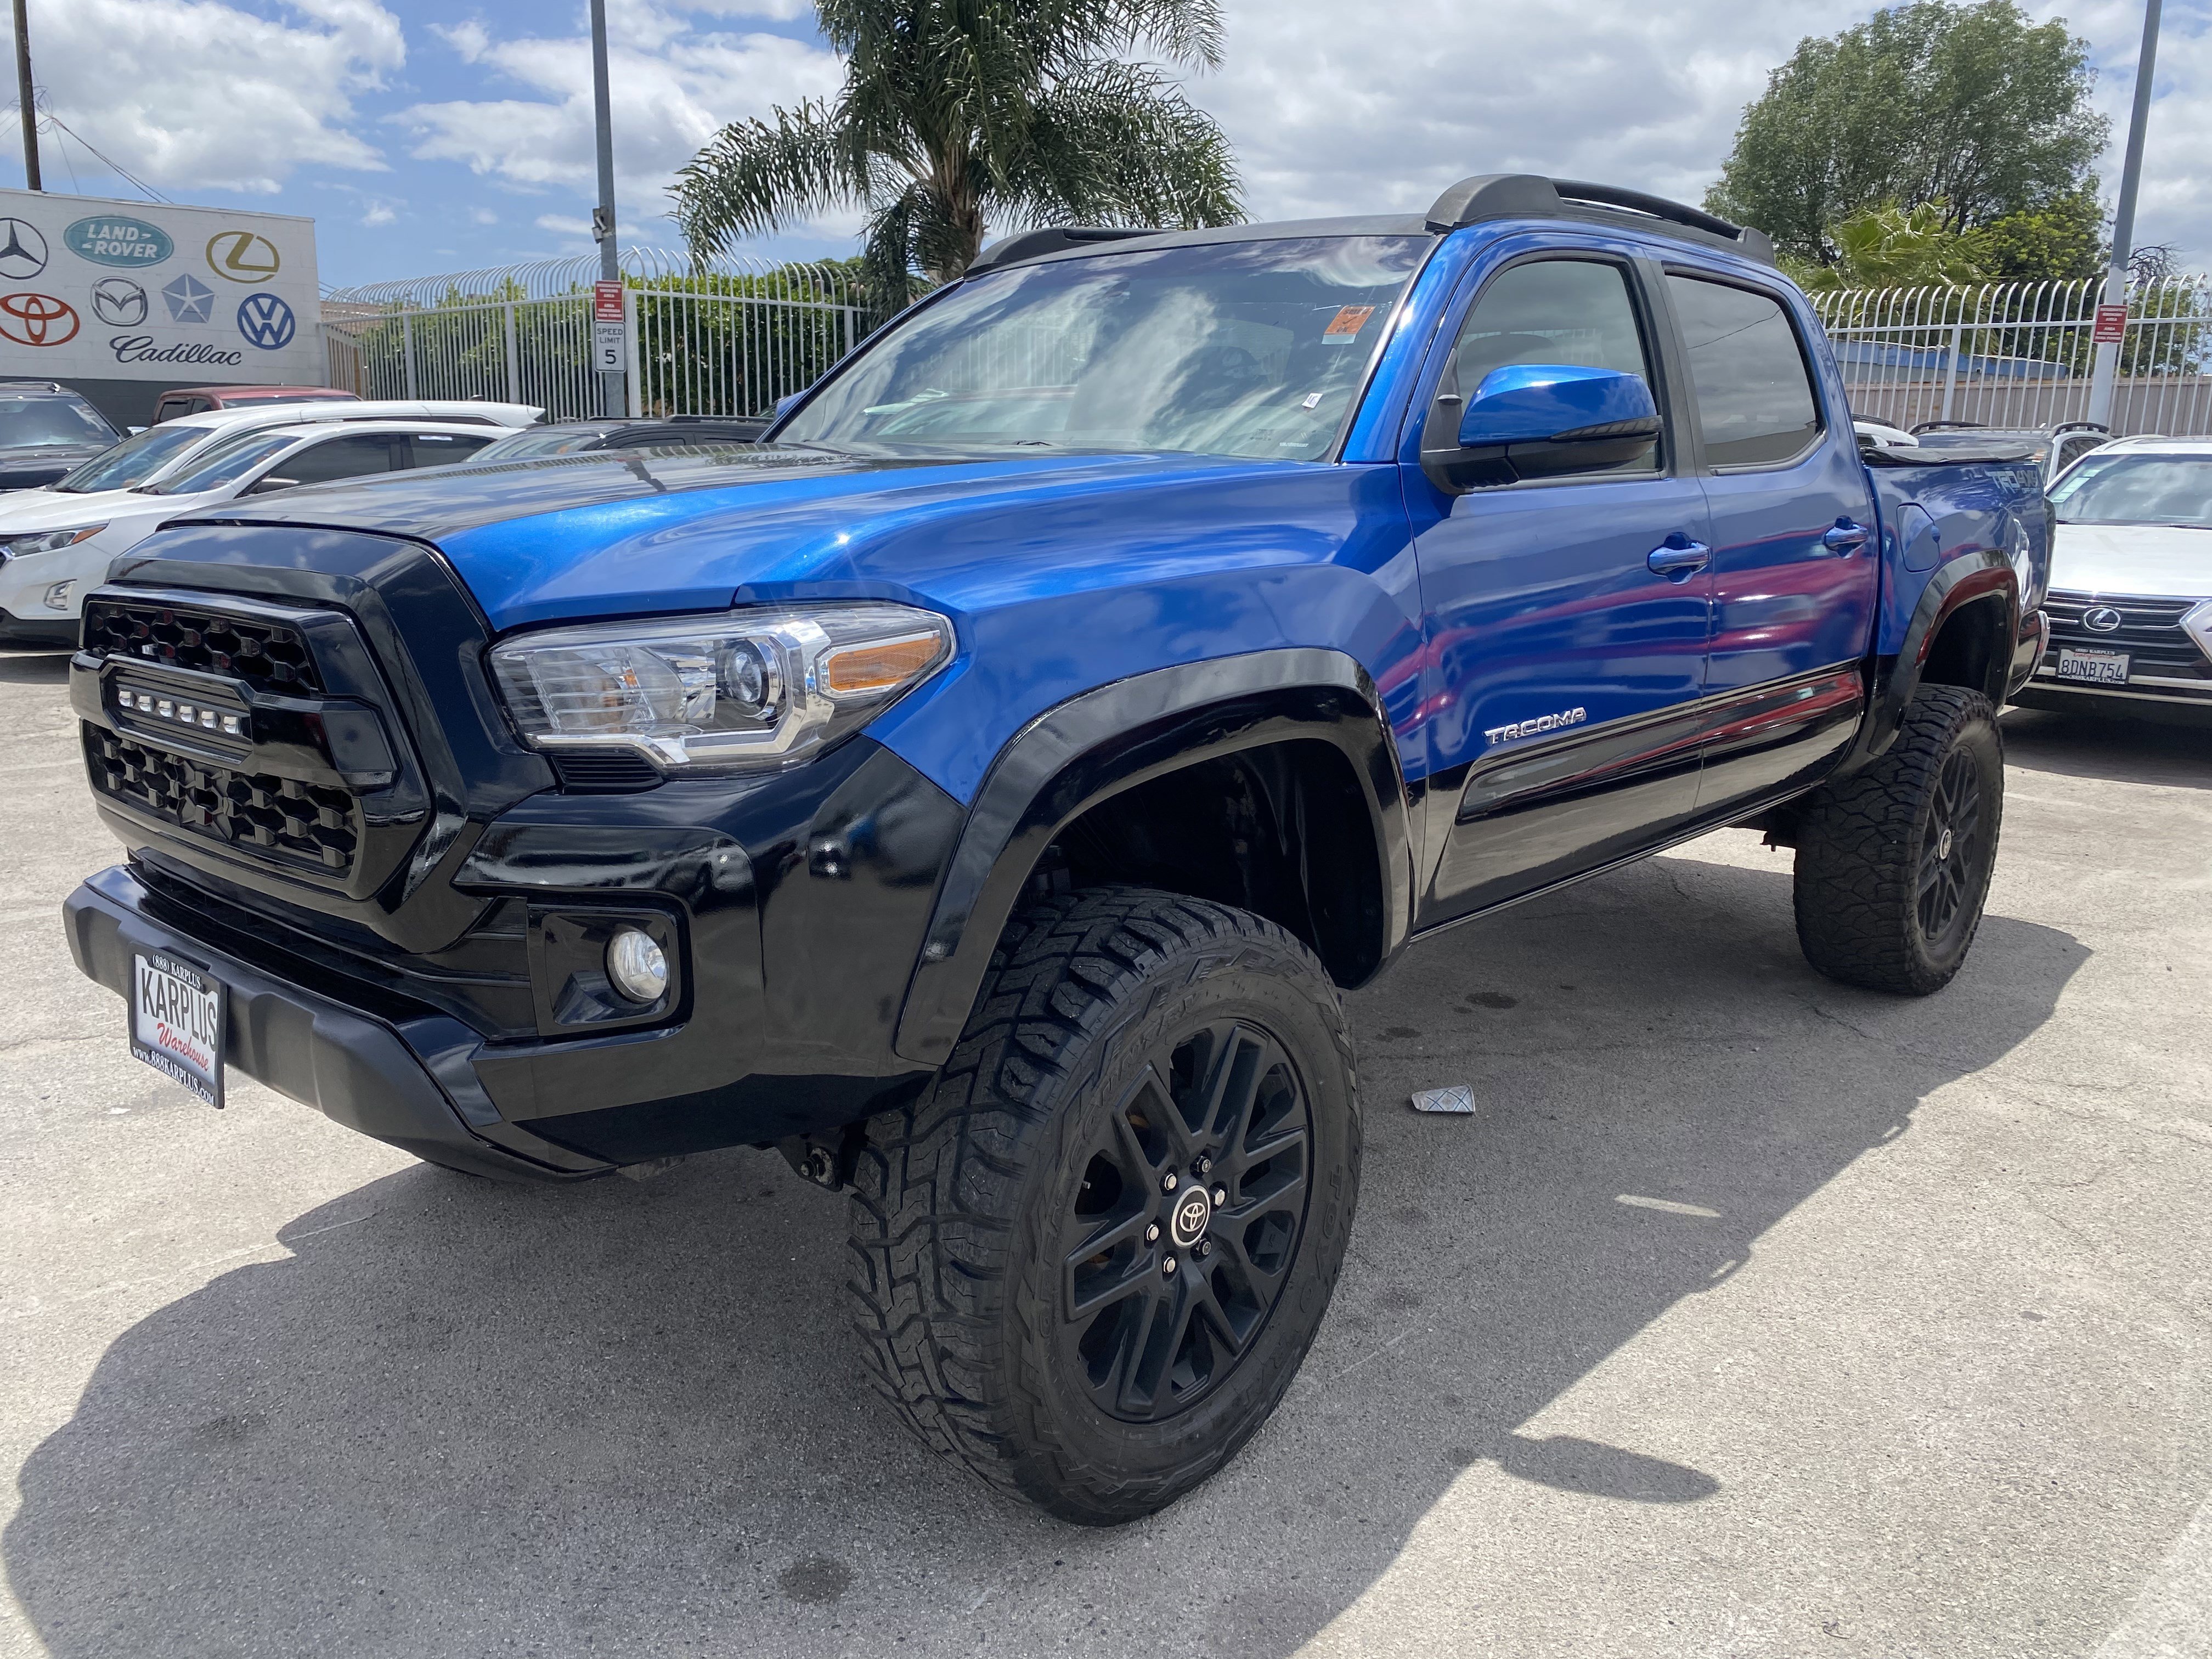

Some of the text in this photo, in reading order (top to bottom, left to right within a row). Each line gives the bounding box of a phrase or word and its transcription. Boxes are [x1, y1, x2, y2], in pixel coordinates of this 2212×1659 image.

[88, 223, 138, 241] LAND
[94, 241, 157, 258] ROVER
[109, 336, 242, 366] Cadillac
[605, 349, 616, 364] 5
[1984, 469, 2020, 494] TRD
[2061, 659, 2123, 678] 8DNB754
[1483, 707, 1587, 745] TACOMA
[153, 954, 201, 989] (888) KARPLUS
[141, 968, 217, 1052] KARPLUS
[157, 1022, 209, 1071] Warehouse
[1299, 1163, 1344, 1314] TOYO
